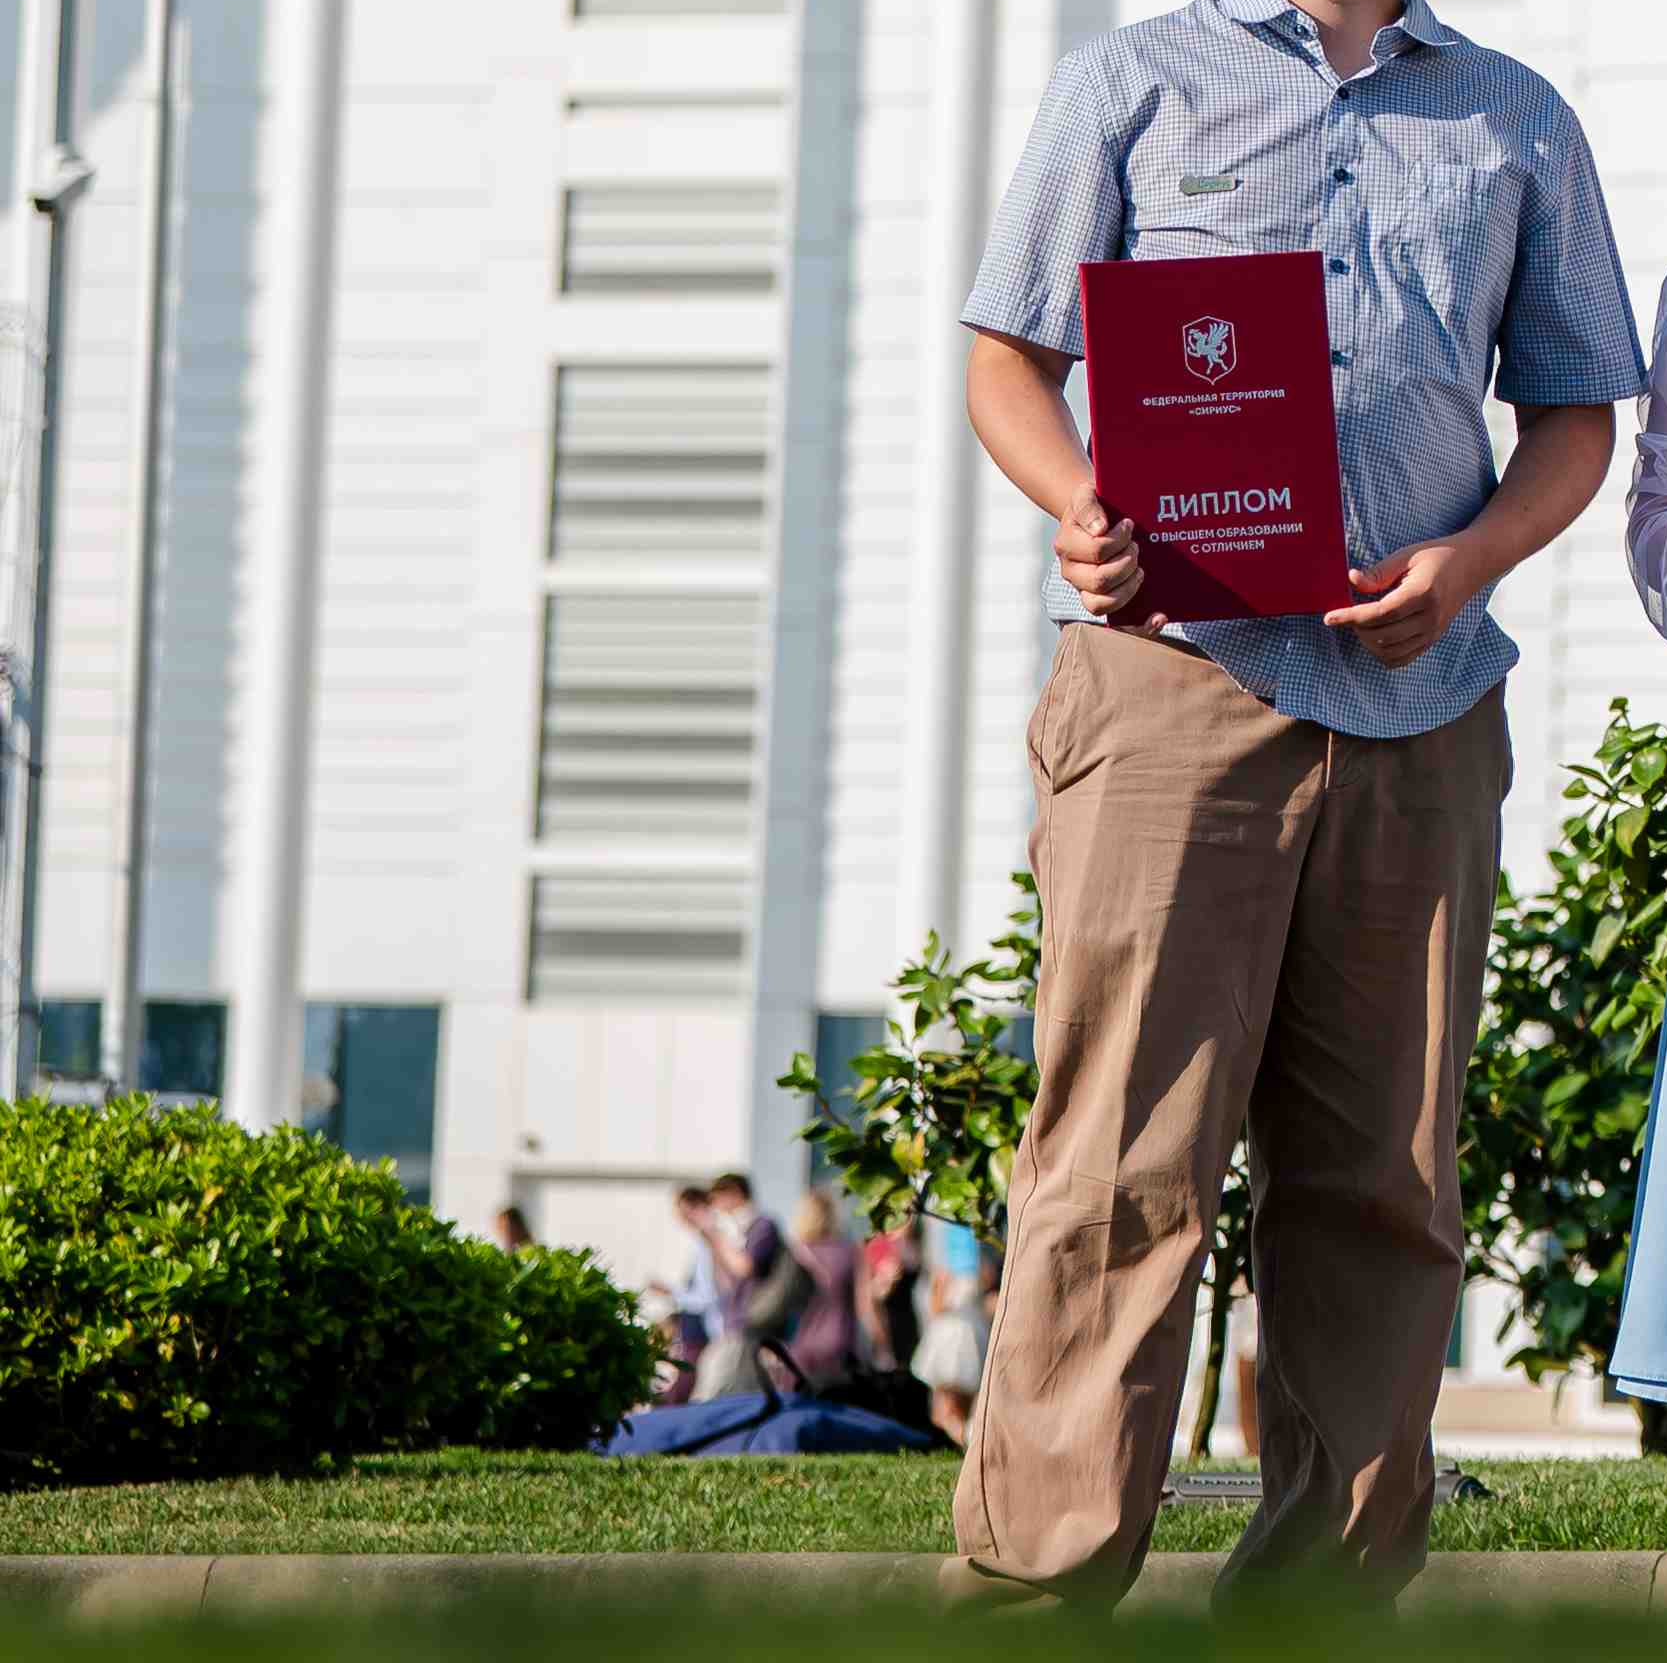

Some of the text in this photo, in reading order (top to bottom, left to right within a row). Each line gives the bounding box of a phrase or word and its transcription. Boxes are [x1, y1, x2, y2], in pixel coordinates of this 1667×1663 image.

[1143, 389, 1285, 407] ФЕДЕРАЛЬНАЯ ТЕРРИТОРИЯ
[1157, 487, 1292, 523] ДИПЛОМ
[1150, 522, 1303, 543] О ВЫСШЕМ ОБРАЗОВАНИИ
[1190, 539, 1265, 554] С ОТЛИЧИЕМ
